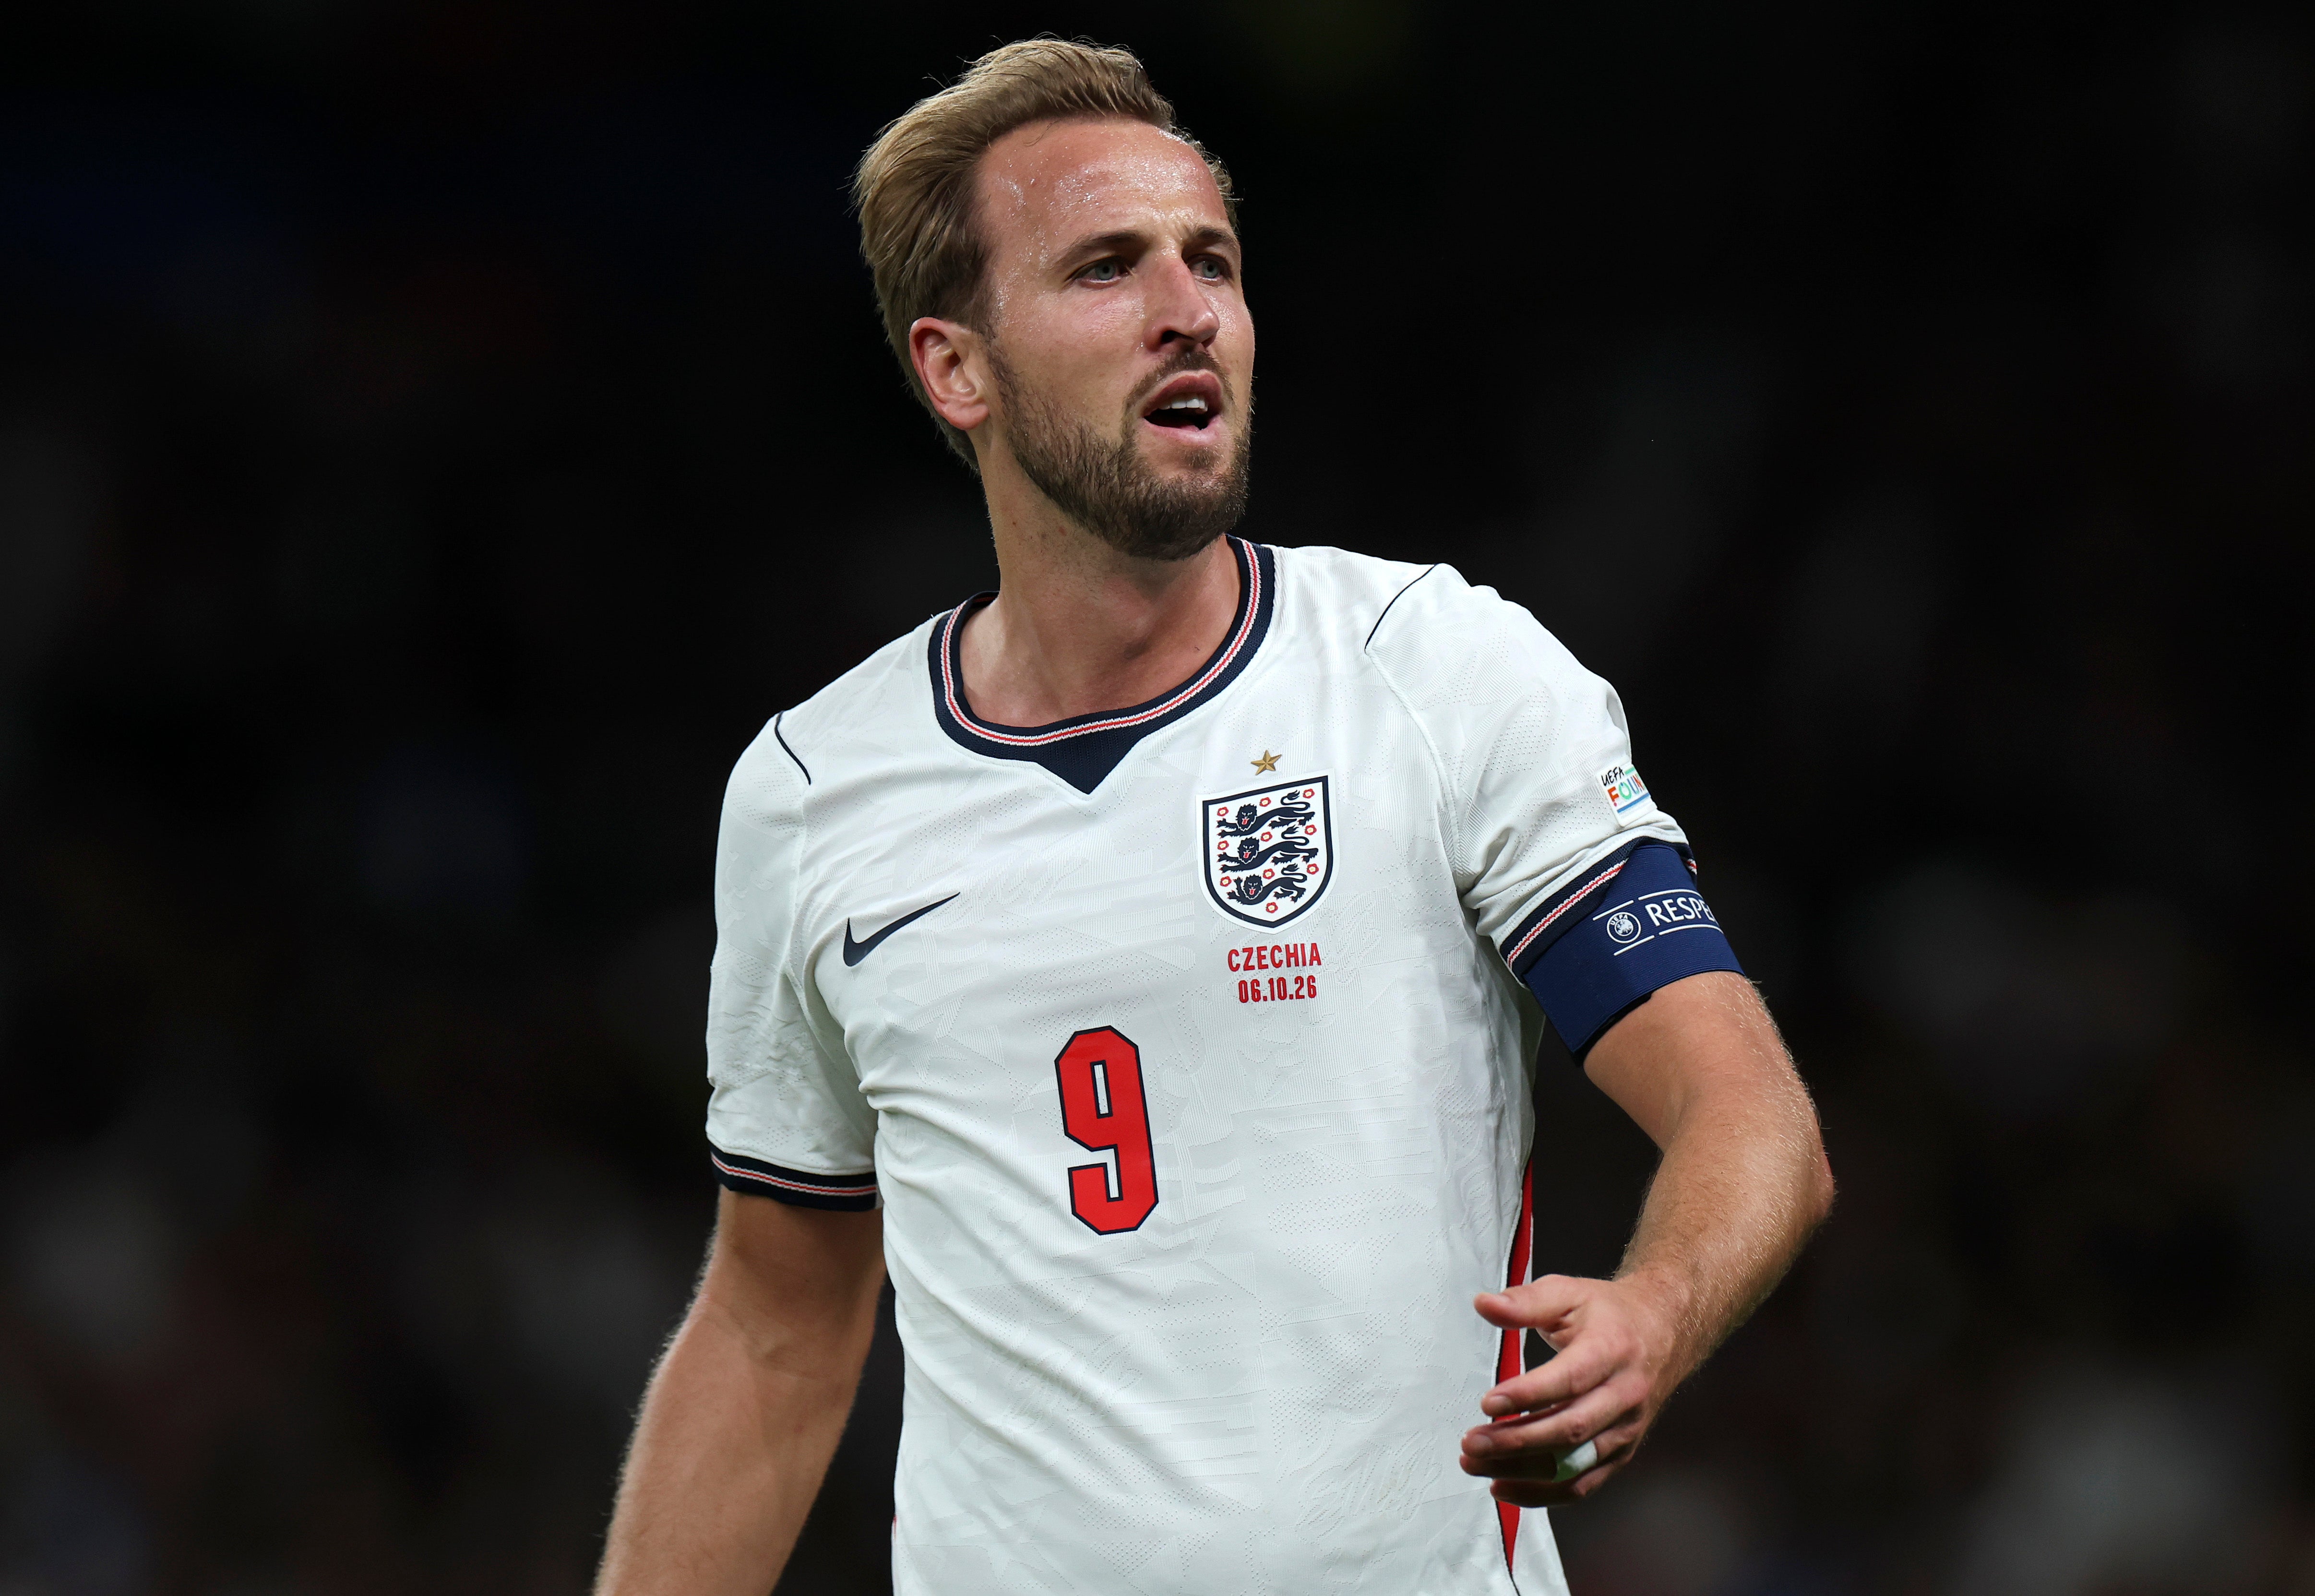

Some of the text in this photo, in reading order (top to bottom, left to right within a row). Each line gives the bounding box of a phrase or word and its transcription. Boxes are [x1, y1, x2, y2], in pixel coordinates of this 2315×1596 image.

[1601, 767, 1624, 786] UEFA
[1607, 774, 1647, 807] FOUN
[1610, 914, 1628, 926] UEFA
[1645, 897, 1719, 927] RESPE
[1228, 942, 1322, 972] CZECHIA
[1238, 975, 1317, 1003] 06.10.26
[1054, 1025, 1159, 1236] 9
